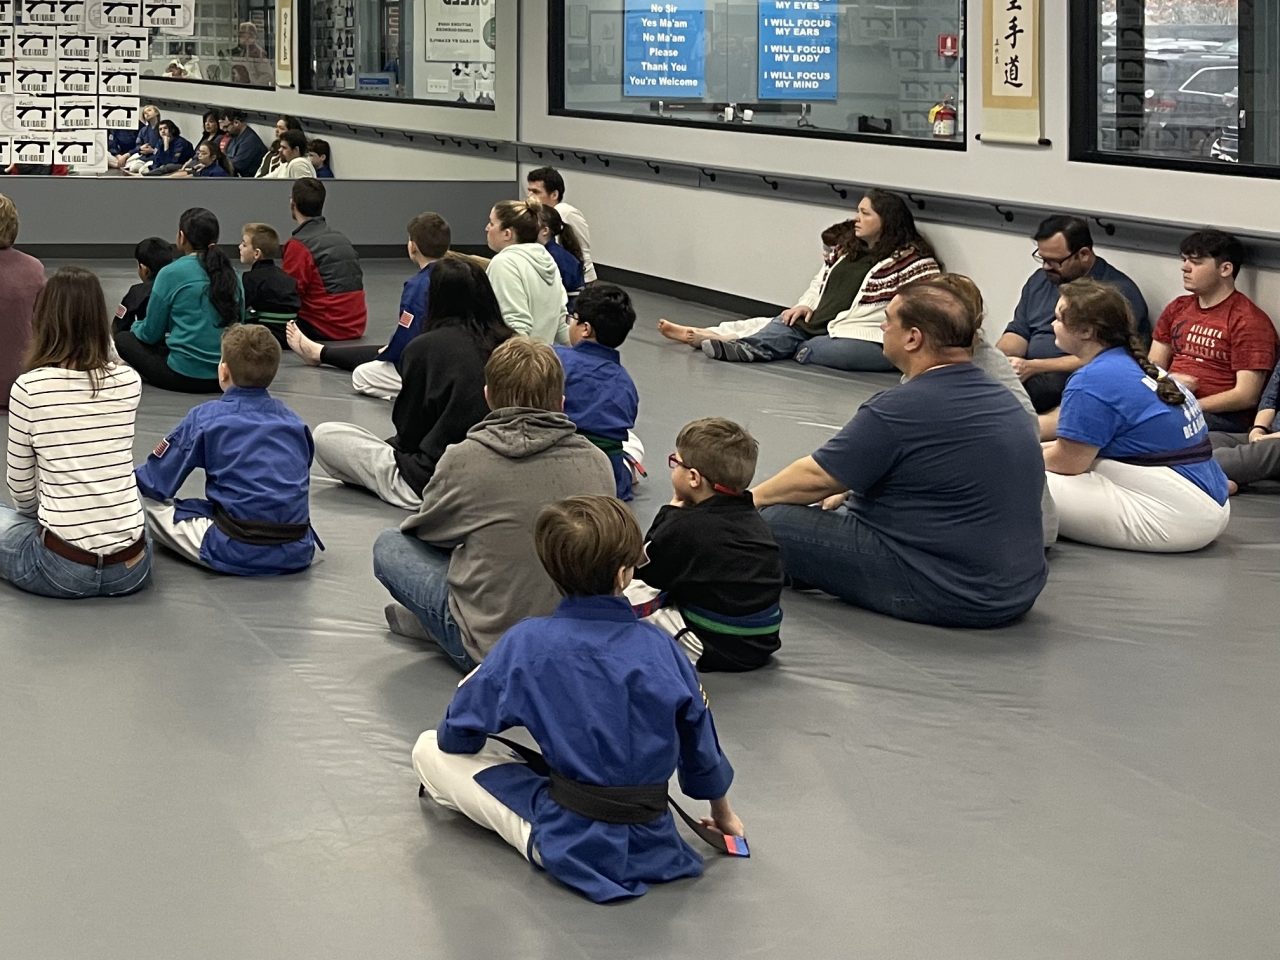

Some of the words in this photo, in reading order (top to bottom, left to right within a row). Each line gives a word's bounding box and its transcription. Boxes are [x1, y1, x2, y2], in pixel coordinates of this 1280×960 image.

[650, 4, 664, 13] No
[665, 4, 678, 13] Sir
[775, 1, 791, 10] MY
[793, 1, 820, 10] EYES
[641, 18, 658, 28] Yes
[660, 18, 688, 28] Ma'am
[770, 18, 795, 27] WILL
[797, 18, 831, 28] FOCUS
[775, 27, 791, 36] MY
[793, 27, 820, 36] EARS
[642, 33, 656, 42] No
[657, 33, 686, 43] Ma'am
[649, 47, 679, 57] Please
[770, 45, 795, 54] WILL
[797, 45, 831, 54] FOCUS
[775, 54, 791, 63] MY
[792, 54, 820, 63] BODY
[641, 62, 669, 72] Thank
[670, 62, 687, 72] You
[770, 72, 794, 80] WILL
[797, 72, 831, 80] FOCUS
[629, 76, 657, 87] You're
[658, 76, 698, 87] Welcome
[775, 80, 790, 89] MY
[792, 80, 819, 89] MIND
[1190, 324, 1223, 340] ATLANTA
[1186, 333, 1216, 348] BRAVES
